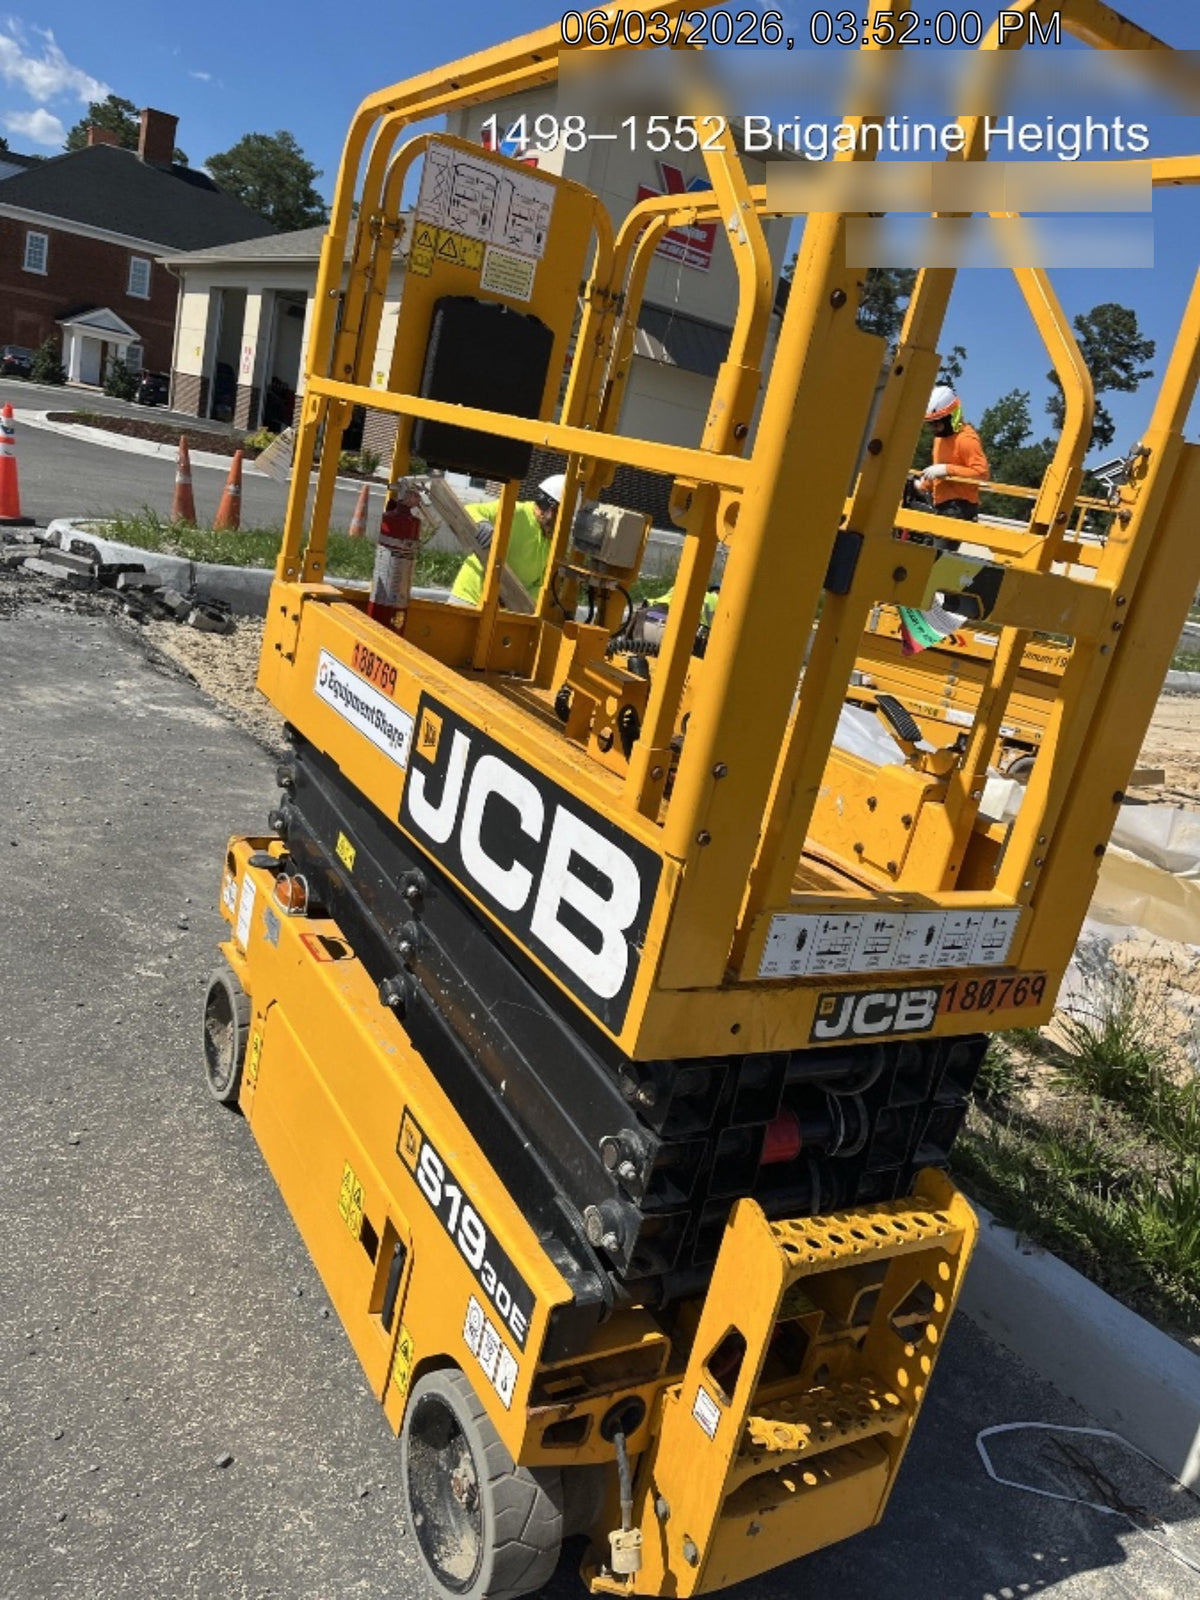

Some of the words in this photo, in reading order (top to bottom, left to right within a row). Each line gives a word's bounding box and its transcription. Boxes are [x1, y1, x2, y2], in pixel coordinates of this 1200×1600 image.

[327, 669, 405, 745] EquipmentShare
[408, 728, 641, 999] JCB
[815, 989, 937, 1037] JCB
[945, 975, 1047, 1013] 180769
